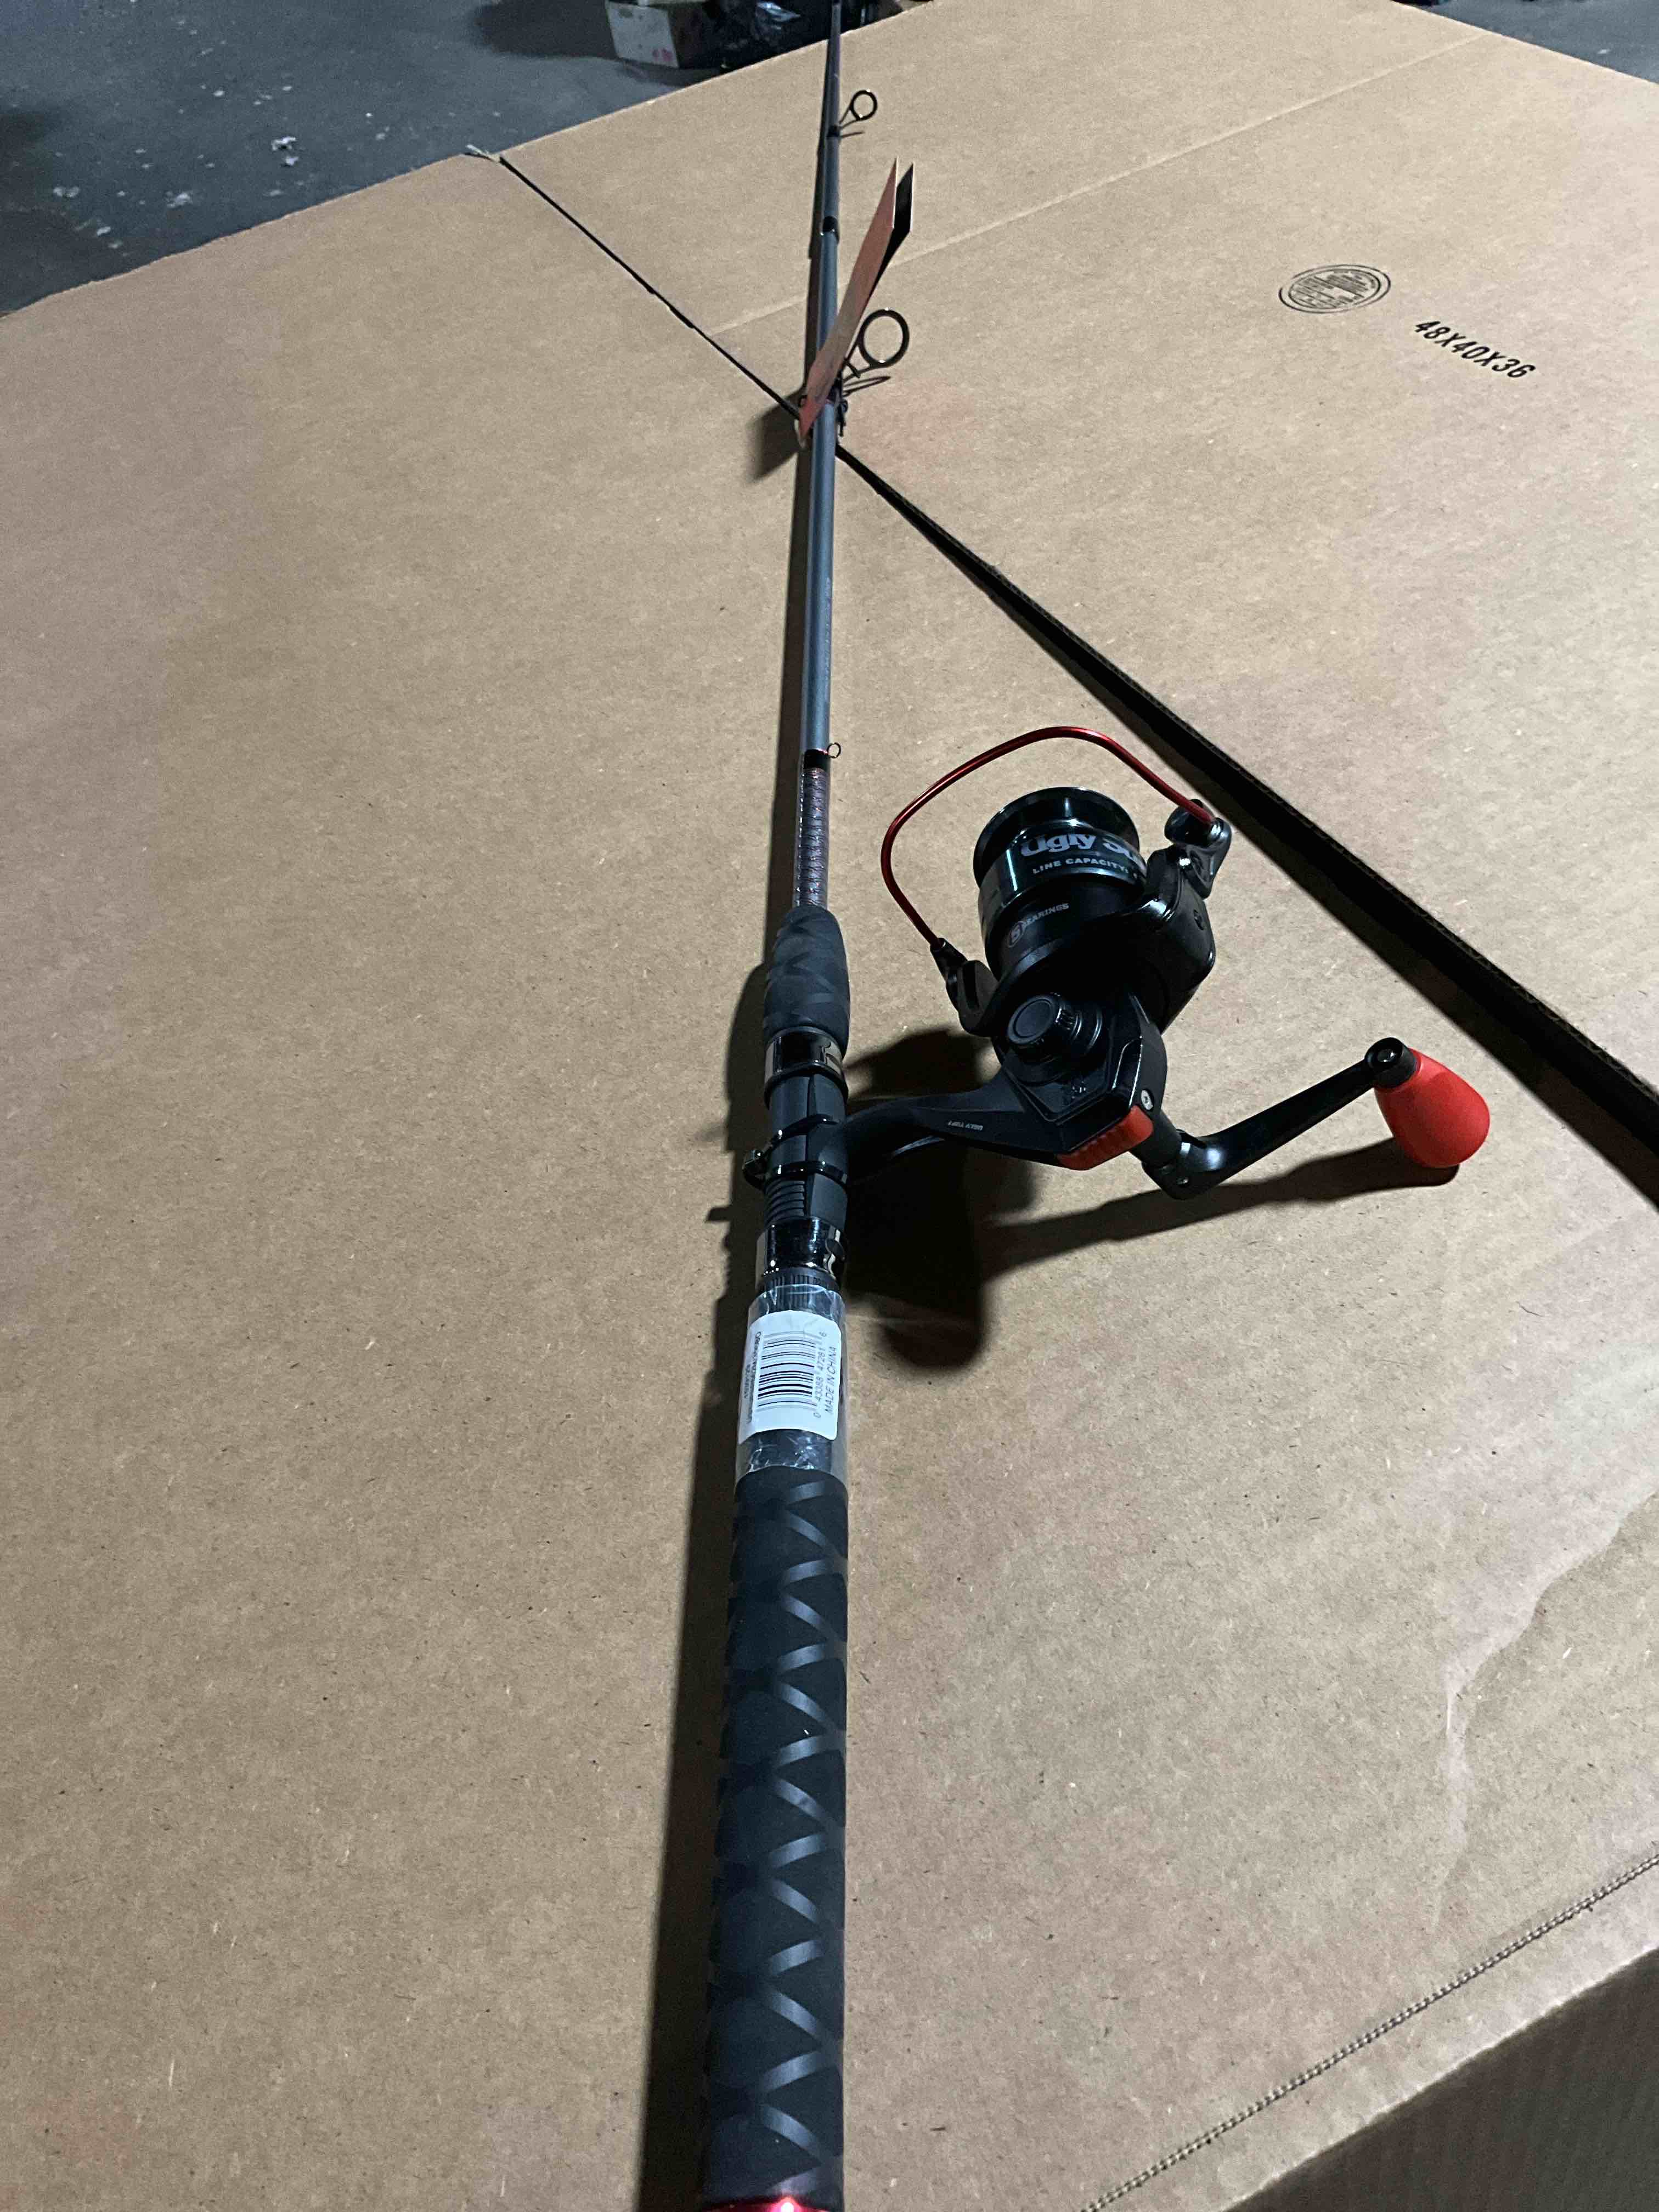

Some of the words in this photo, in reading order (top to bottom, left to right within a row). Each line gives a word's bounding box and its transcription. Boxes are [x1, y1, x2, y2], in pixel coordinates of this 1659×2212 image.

[1414, 320, 1536, 378] 48X40X36
[1021, 833, 1097, 856] Ugly
[1032, 860, 1061, 874] LINE
[826, 1346, 837, 1374] CHINA
[825, 1383, 835, 1414] MADE
